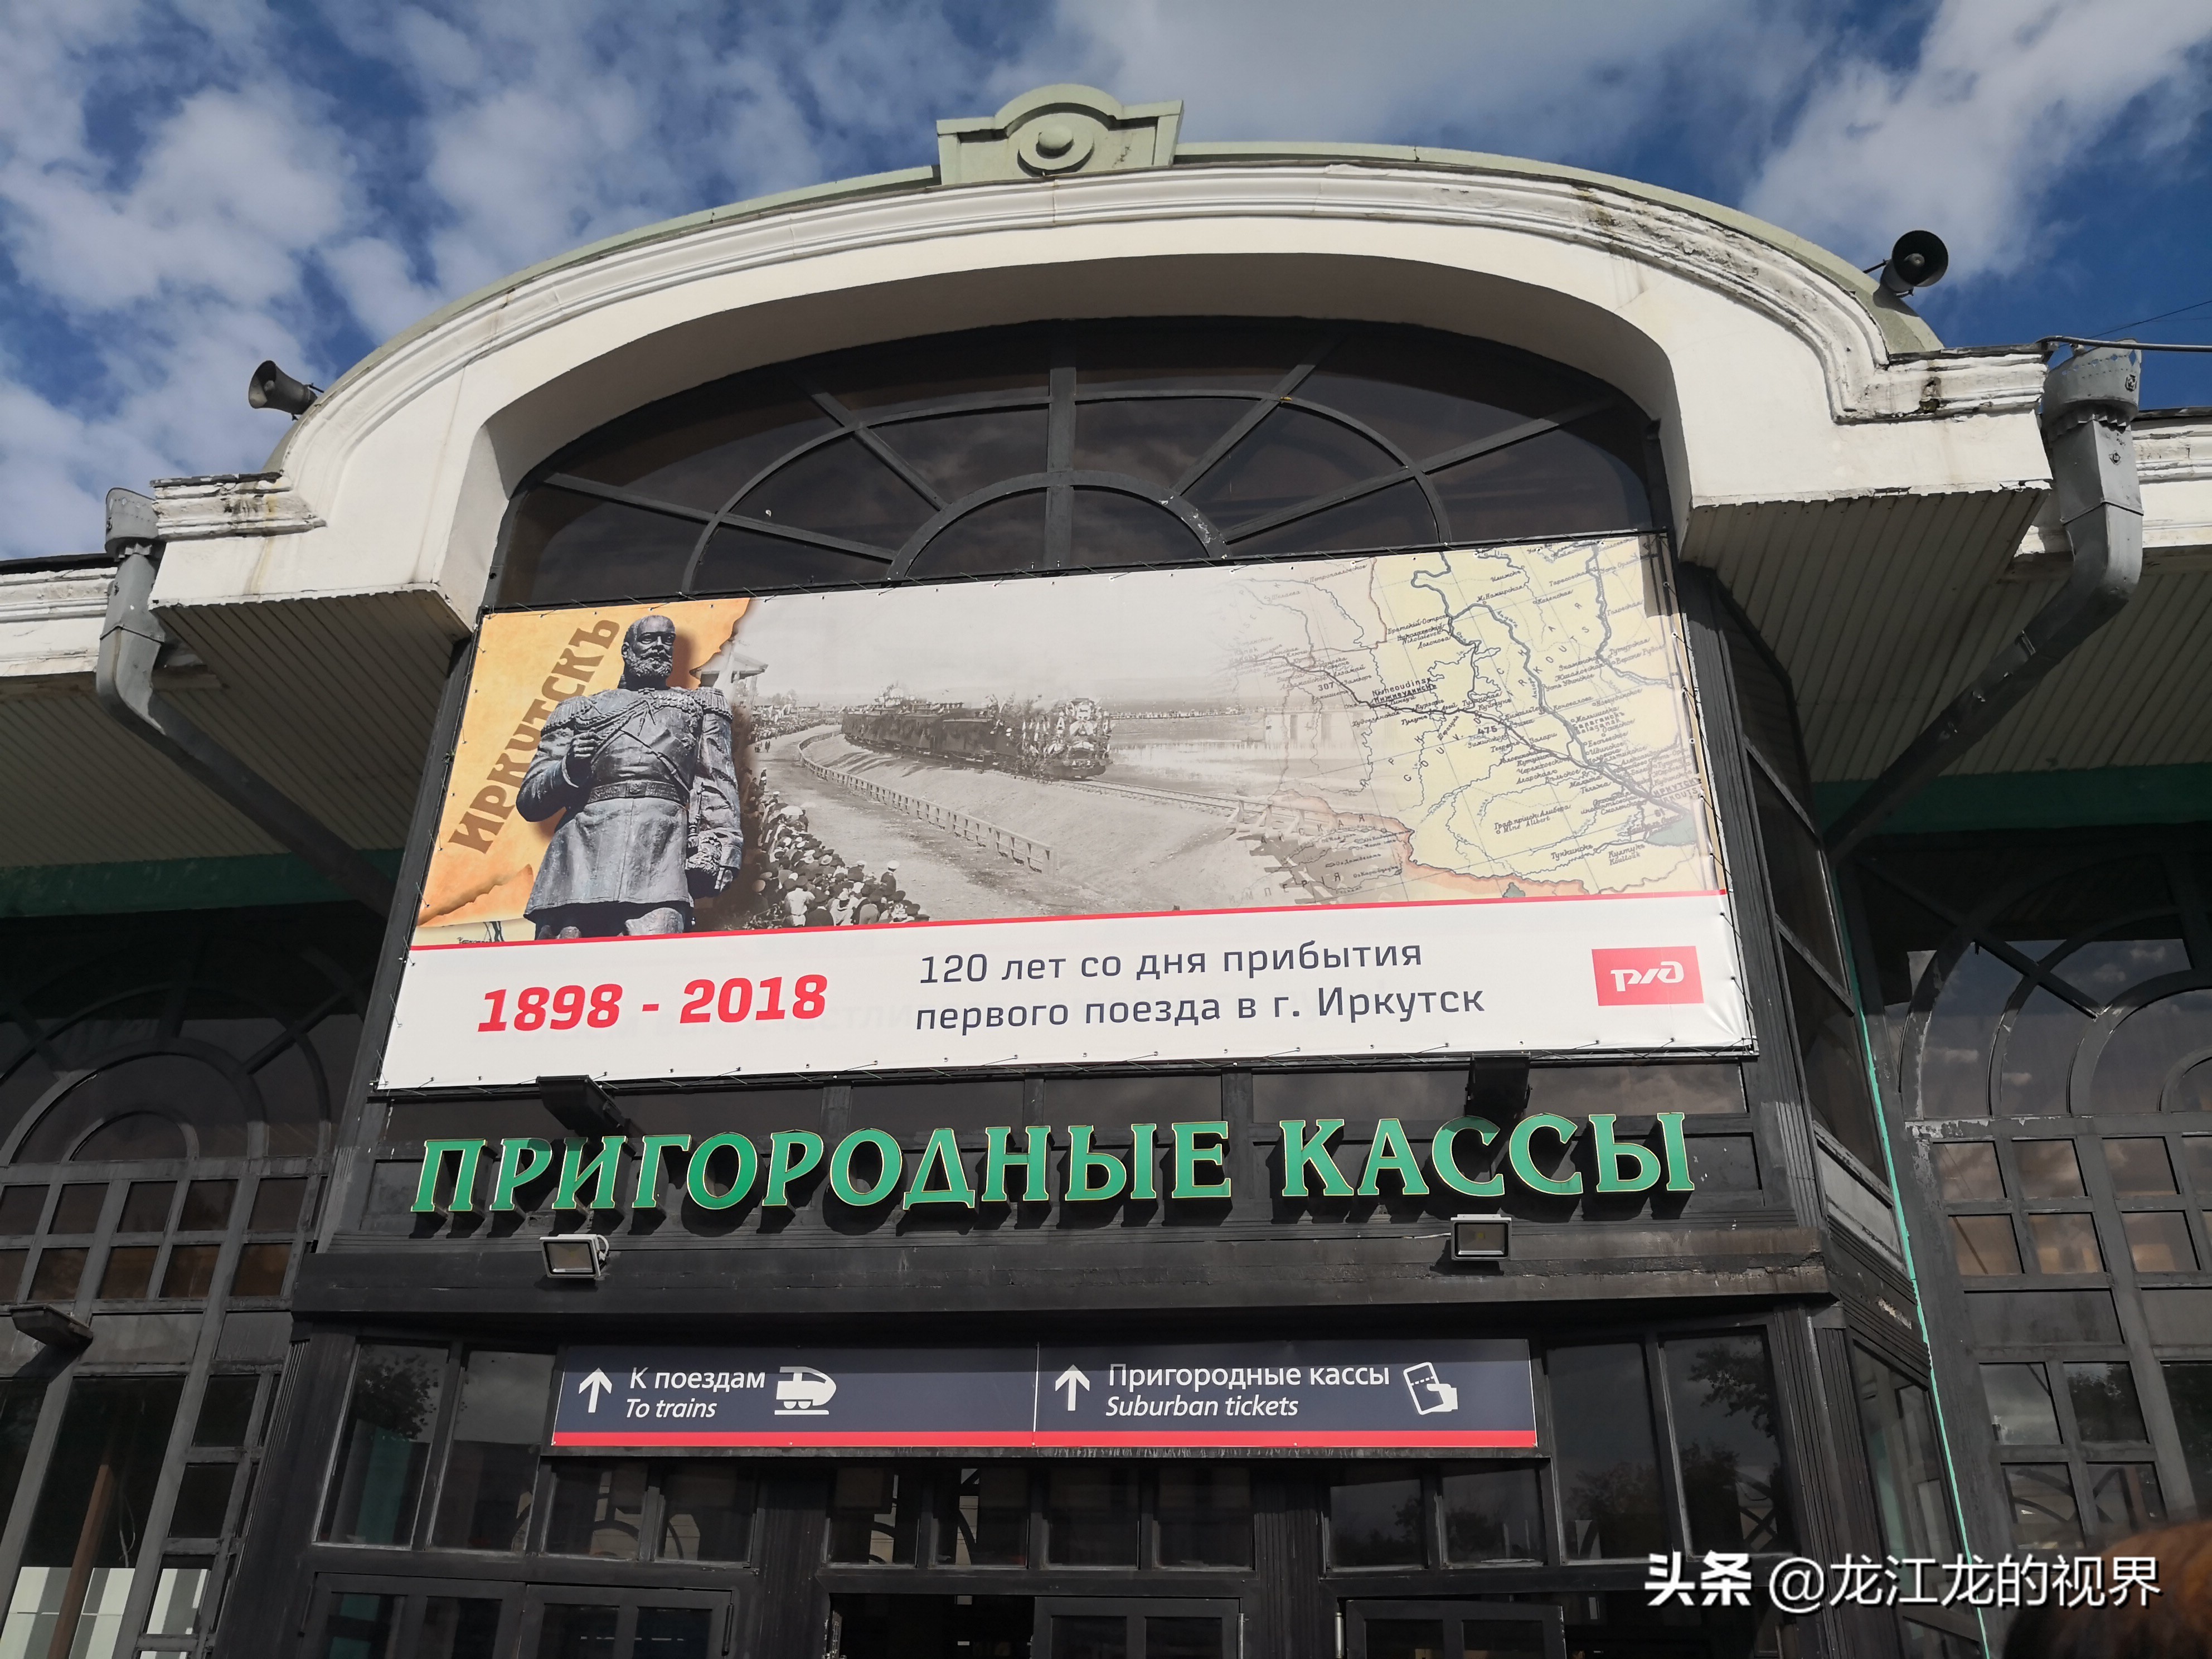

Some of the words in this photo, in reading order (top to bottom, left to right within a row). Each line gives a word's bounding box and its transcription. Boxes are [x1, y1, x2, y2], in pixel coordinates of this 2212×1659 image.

[1318, 682, 1334, 692] 307
[1477, 725, 1498, 735] 475
[920, 953, 988, 984] 120
[1001, 958, 1066, 981] лет
[1081, 955, 1122, 977] со
[1136, 953, 1206, 979] дня
[1224, 940, 1422, 978] прибытия
[478, 983, 623, 1032] 1898
[680, 974, 828, 1024] 2018
[916, 1004, 1069, 1036] первого
[1085, 998, 1220, 1026] поезда
[1238, 997, 1257, 1018] в
[1274, 996, 1300, 1018] г.
[1318, 986, 1484, 1023] Иркутск
[410, 1121, 1231, 1213] ПРИГОРОДНЫЕ
[1278, 1112, 1695, 1197] КАССЫ
[630, 1367, 649, 1390] К
[654, 1370, 766, 1393] поездам
[1108, 1364, 1301, 1393] Пригородные
[1309, 1366, 1390, 1386] кассы
[625, 1398, 649, 1418] To
[655, 1398, 716, 1419] trains
[1105, 1395, 1219, 1418] Suburban
[1225, 1395, 1299, 1417] tickets
